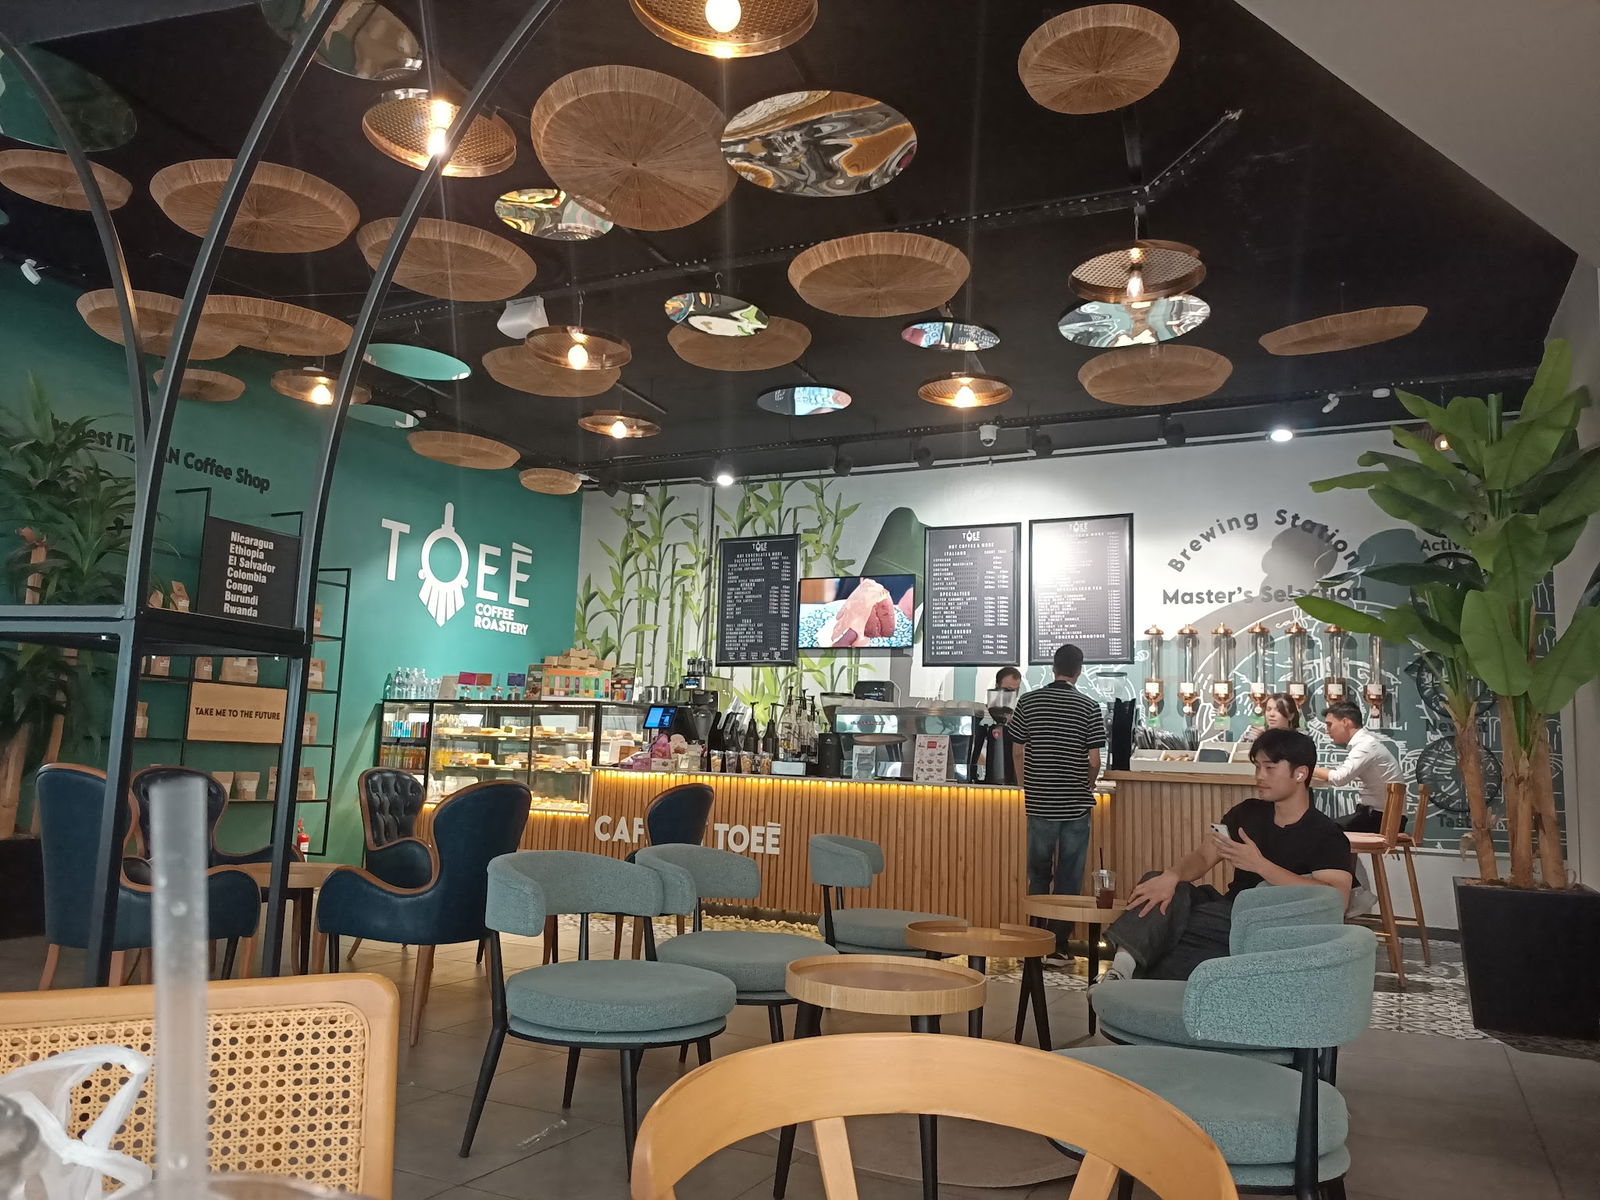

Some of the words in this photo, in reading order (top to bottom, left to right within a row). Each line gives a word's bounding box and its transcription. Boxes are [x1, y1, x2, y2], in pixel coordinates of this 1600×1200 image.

[184, 452, 232, 480] Coffee
[236, 467, 270, 494] Shop
[231, 531, 274, 550] Nicaragua
[1168, 512, 1258, 572] Brewing
[1274, 509, 1360, 570] Station
[230, 543, 264, 560] Ethiopia
[228, 555, 237, 566] El
[239, 557, 276, 573] Salvador
[227, 567, 267, 583] Colombia
[226, 579, 253, 594] Congo
[224, 590, 259, 606] Burundi
[1162, 587, 1253, 605] Master's
[223, 602, 258, 617] Rwanda
[475, 603, 515, 621] COFFEE
[474, 615, 529, 636] ROASTERY
[195, 707, 214, 716] TAKE
[215, 709, 226, 717] ME
[228, 709, 238, 718] TO
[239, 710, 253, 718] THE
[254, 711, 280, 720] FUTURE
